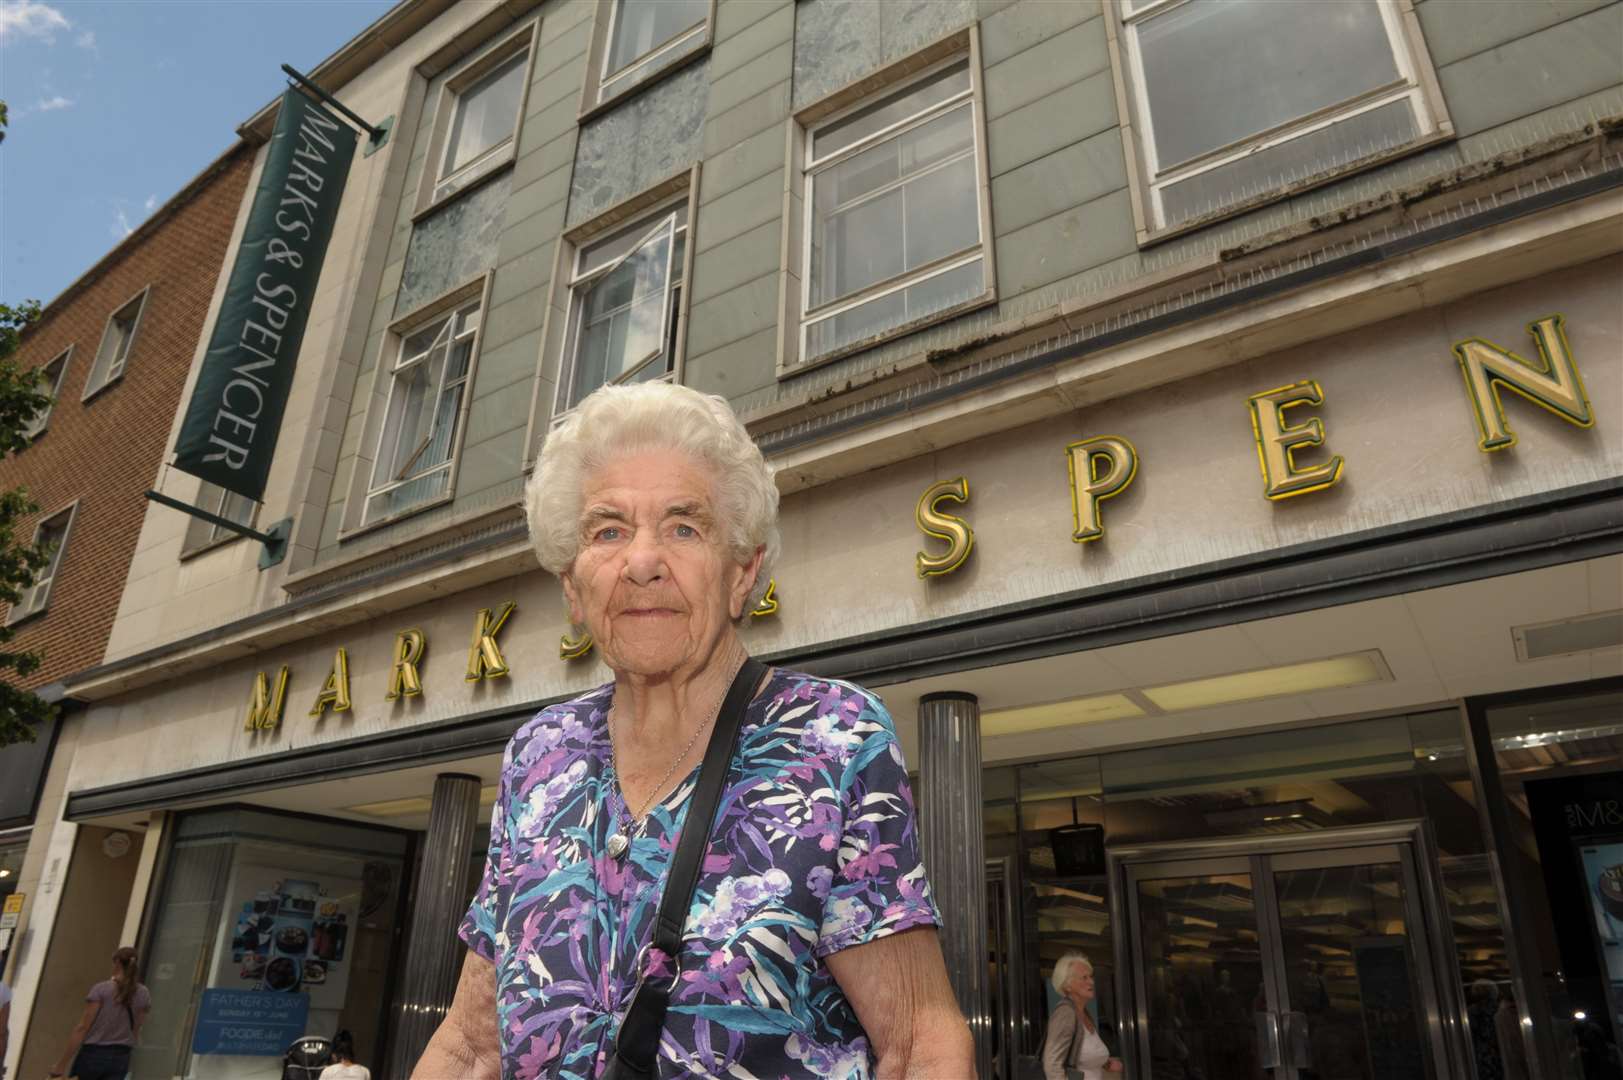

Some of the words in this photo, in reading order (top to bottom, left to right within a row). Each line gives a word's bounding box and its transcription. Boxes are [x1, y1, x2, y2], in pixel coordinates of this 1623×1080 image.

[275, 103, 340, 242] MARKS
[263, 237, 304, 270] &
[201, 272, 297, 471] SPENCER
[914, 312, 1594, 579] SPEN
[209, 993, 273, 1009] FATHER'S
[277, 998, 302, 1009] DAY
